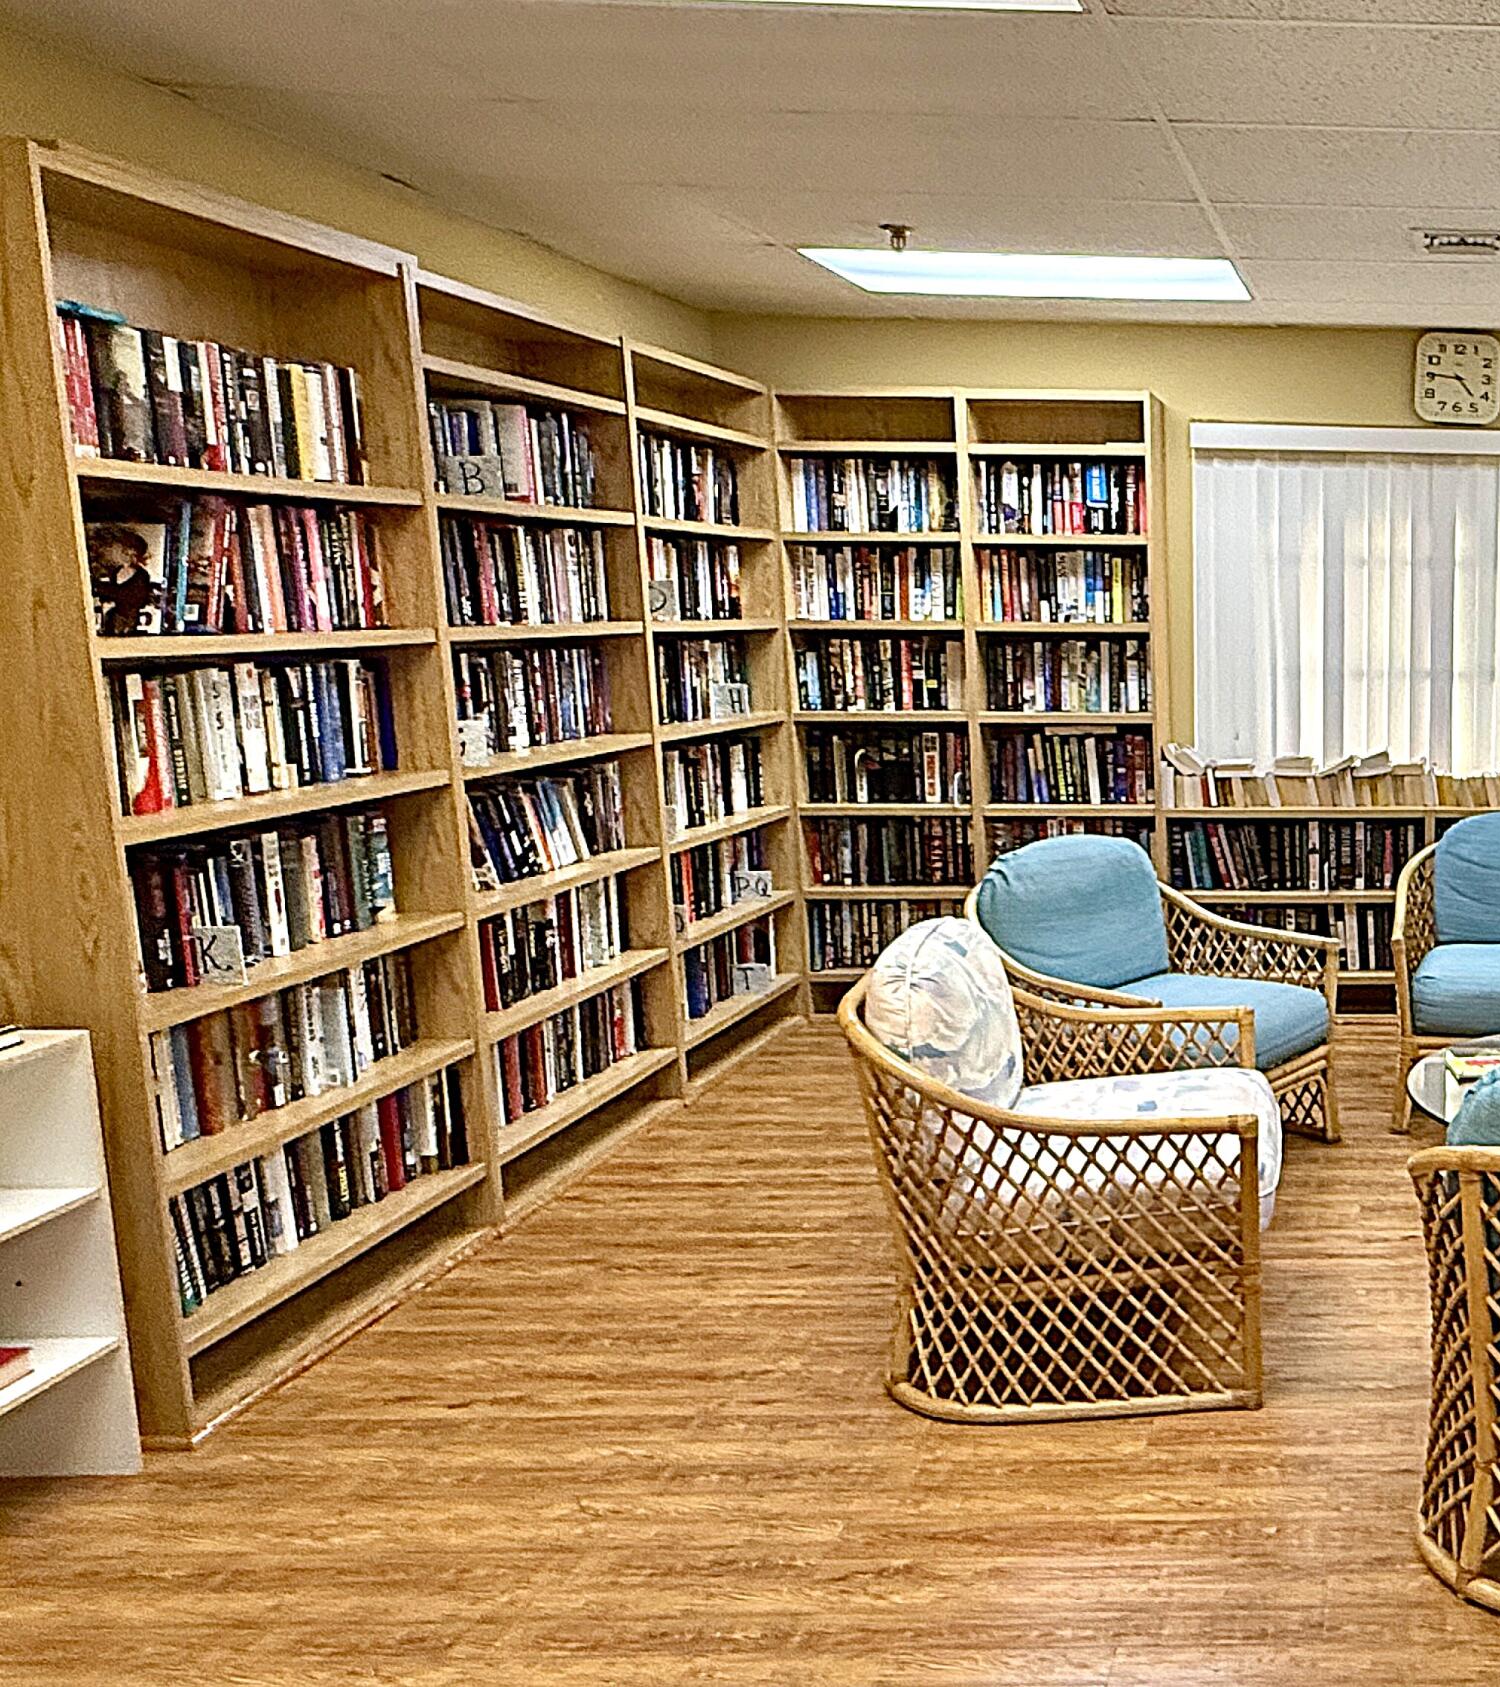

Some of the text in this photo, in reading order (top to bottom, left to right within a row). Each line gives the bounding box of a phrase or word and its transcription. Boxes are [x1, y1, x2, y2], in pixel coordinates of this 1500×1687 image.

[1454, 344, 1467, 355] 12
[1473, 345, 1479, 355] 1
[1428, 355, 1492, 368] 10 2
[1482, 374, 1491, 385] 3
[1425, 388, 1490, 401] 8 4
[1437, 401, 1479, 413] 7 6 5
[459, 461, 485, 495] B
[728, 688, 745, 714] H
[737, 967, 754, 991] T
